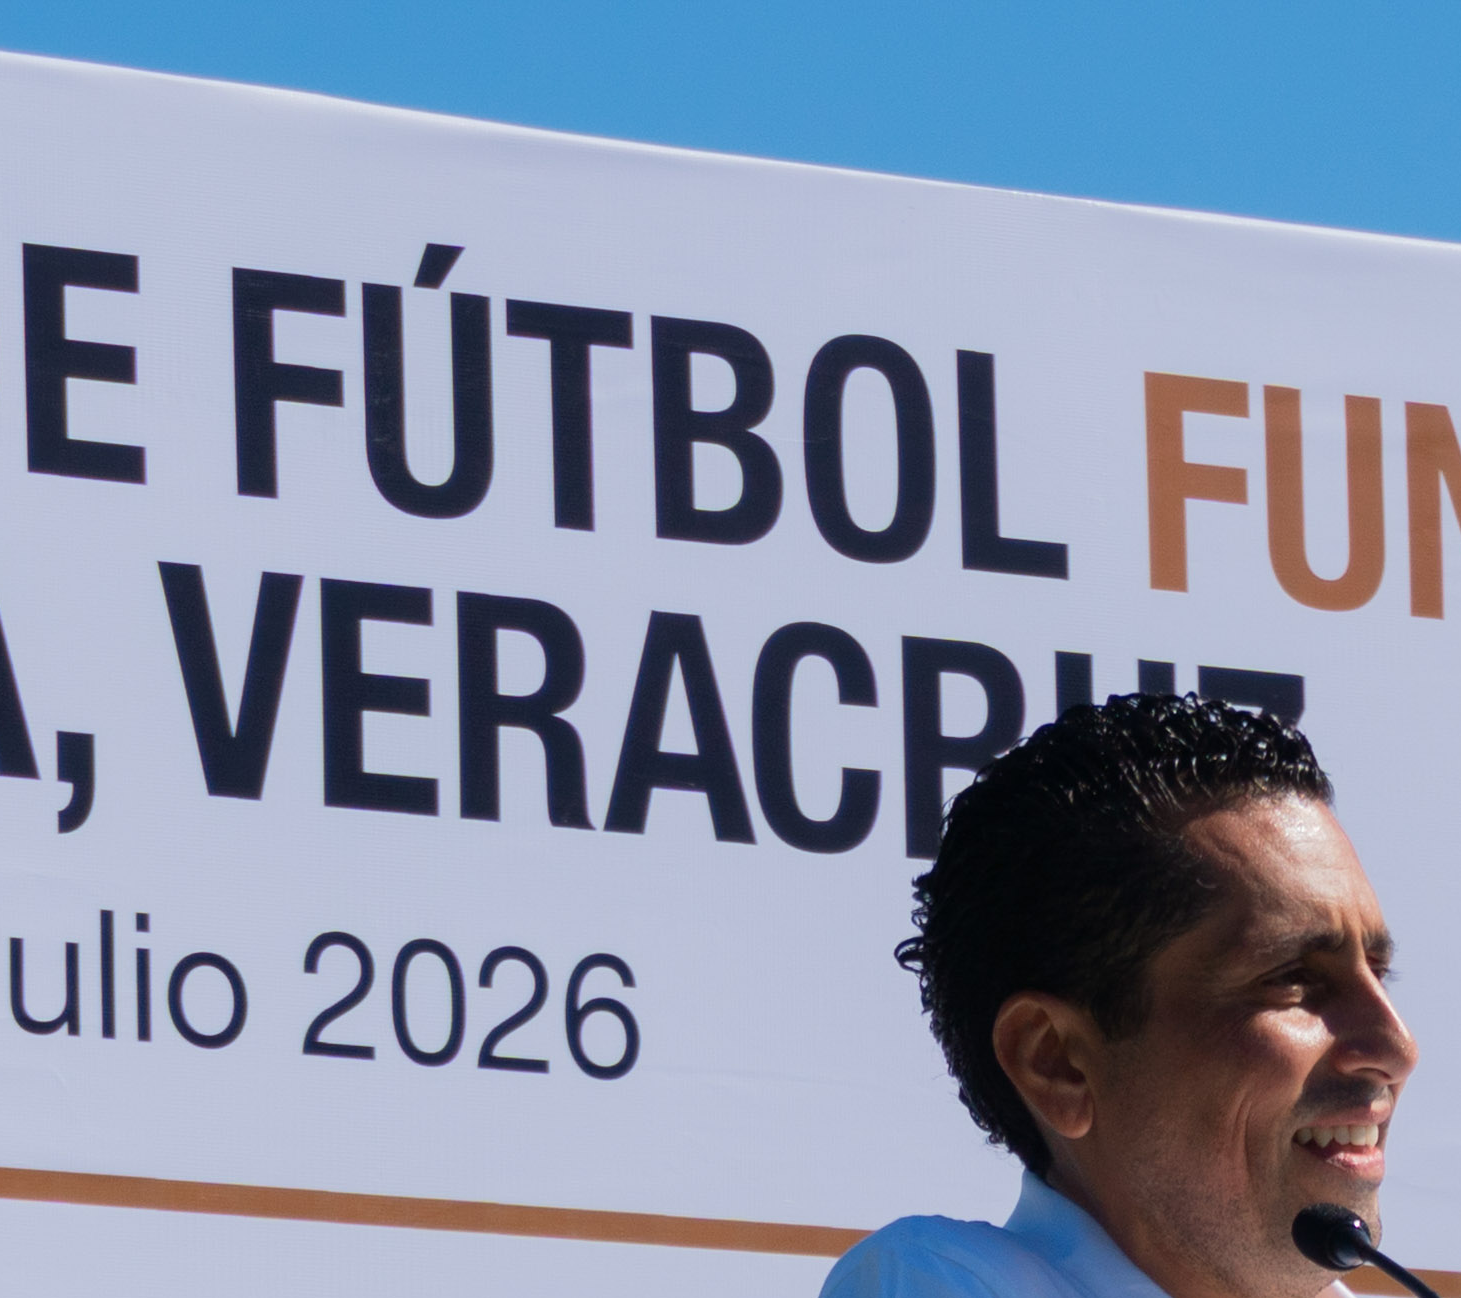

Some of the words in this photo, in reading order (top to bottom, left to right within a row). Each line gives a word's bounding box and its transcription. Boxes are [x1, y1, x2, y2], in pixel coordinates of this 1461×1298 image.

[232, 243, 1068, 580] FÚTBOL
[157, 560, 1305, 860] VERACR
[303, 932, 639, 1080] 2026
